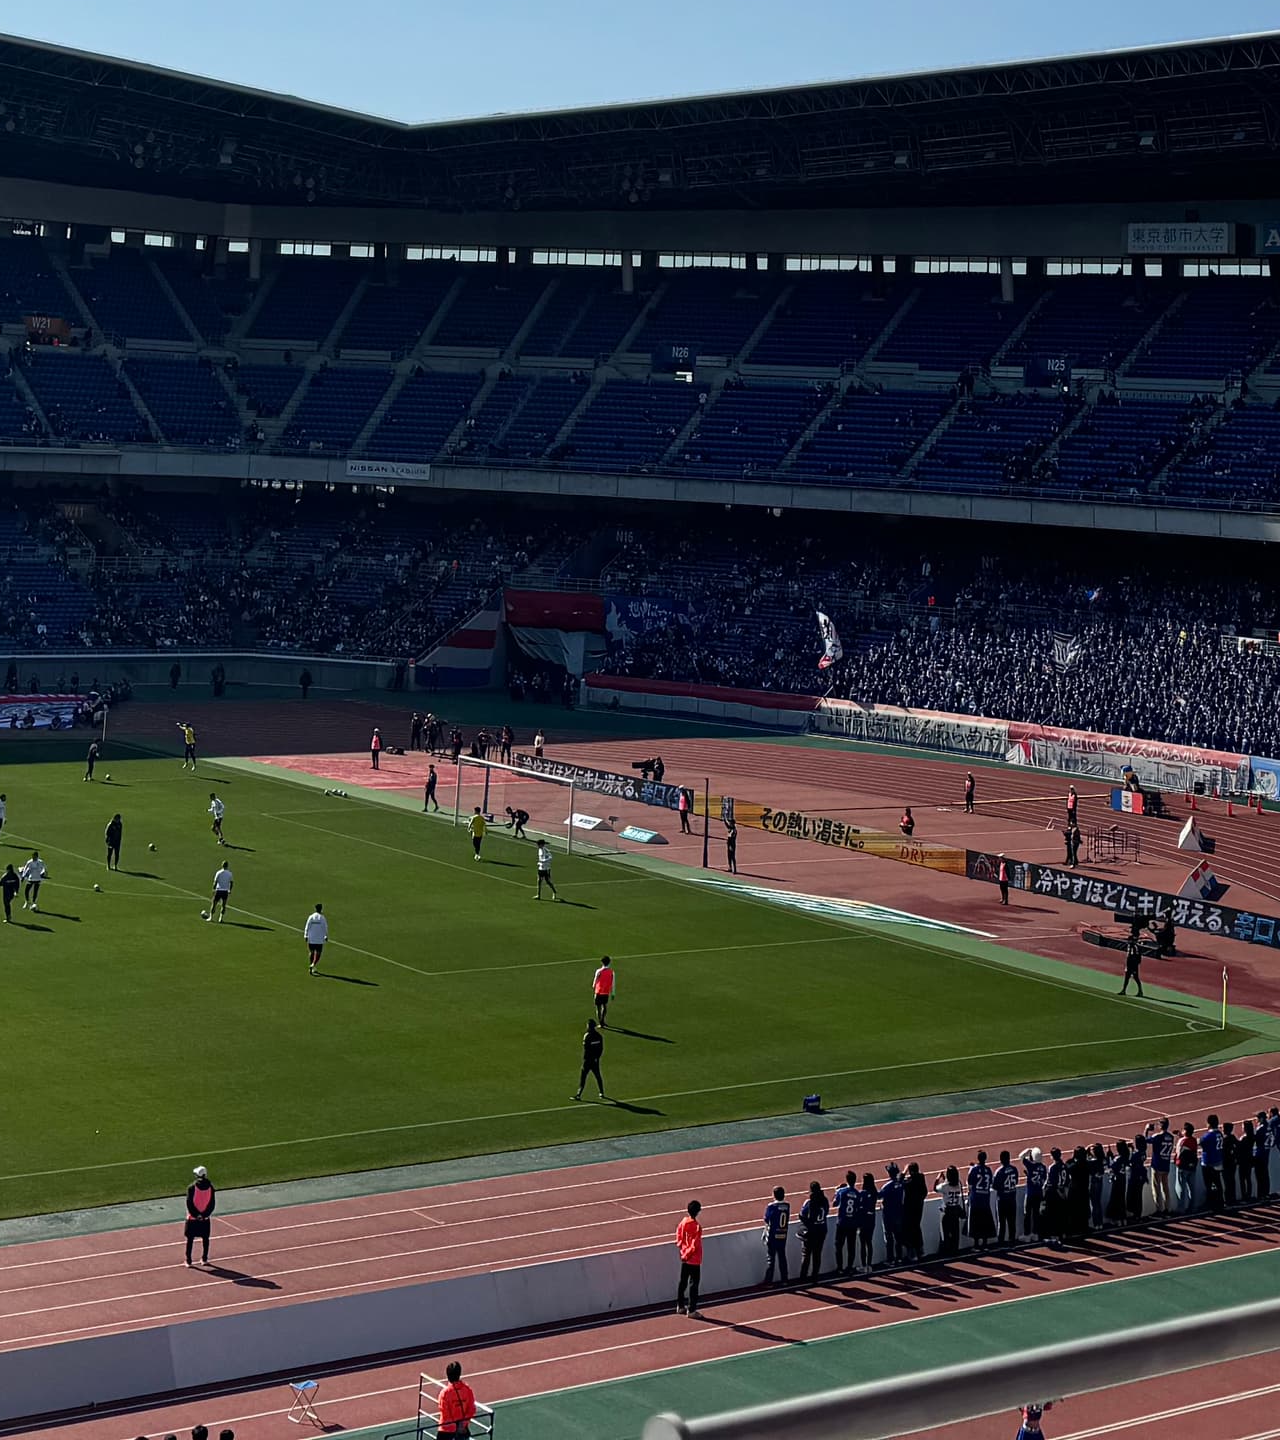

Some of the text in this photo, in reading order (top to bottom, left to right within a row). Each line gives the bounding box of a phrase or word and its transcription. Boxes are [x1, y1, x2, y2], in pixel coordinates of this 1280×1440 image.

[1132, 227, 1225, 243] 東京都市大学
[32, 317, 51, 329] W21
[672, 346, 689, 358] N26
[1047, 359, 1065, 372] N25
[350, 464, 387, 473] NISSAN
[976, 1174, 991, 1190] 23
[846, 1199, 854, 1213] 8
